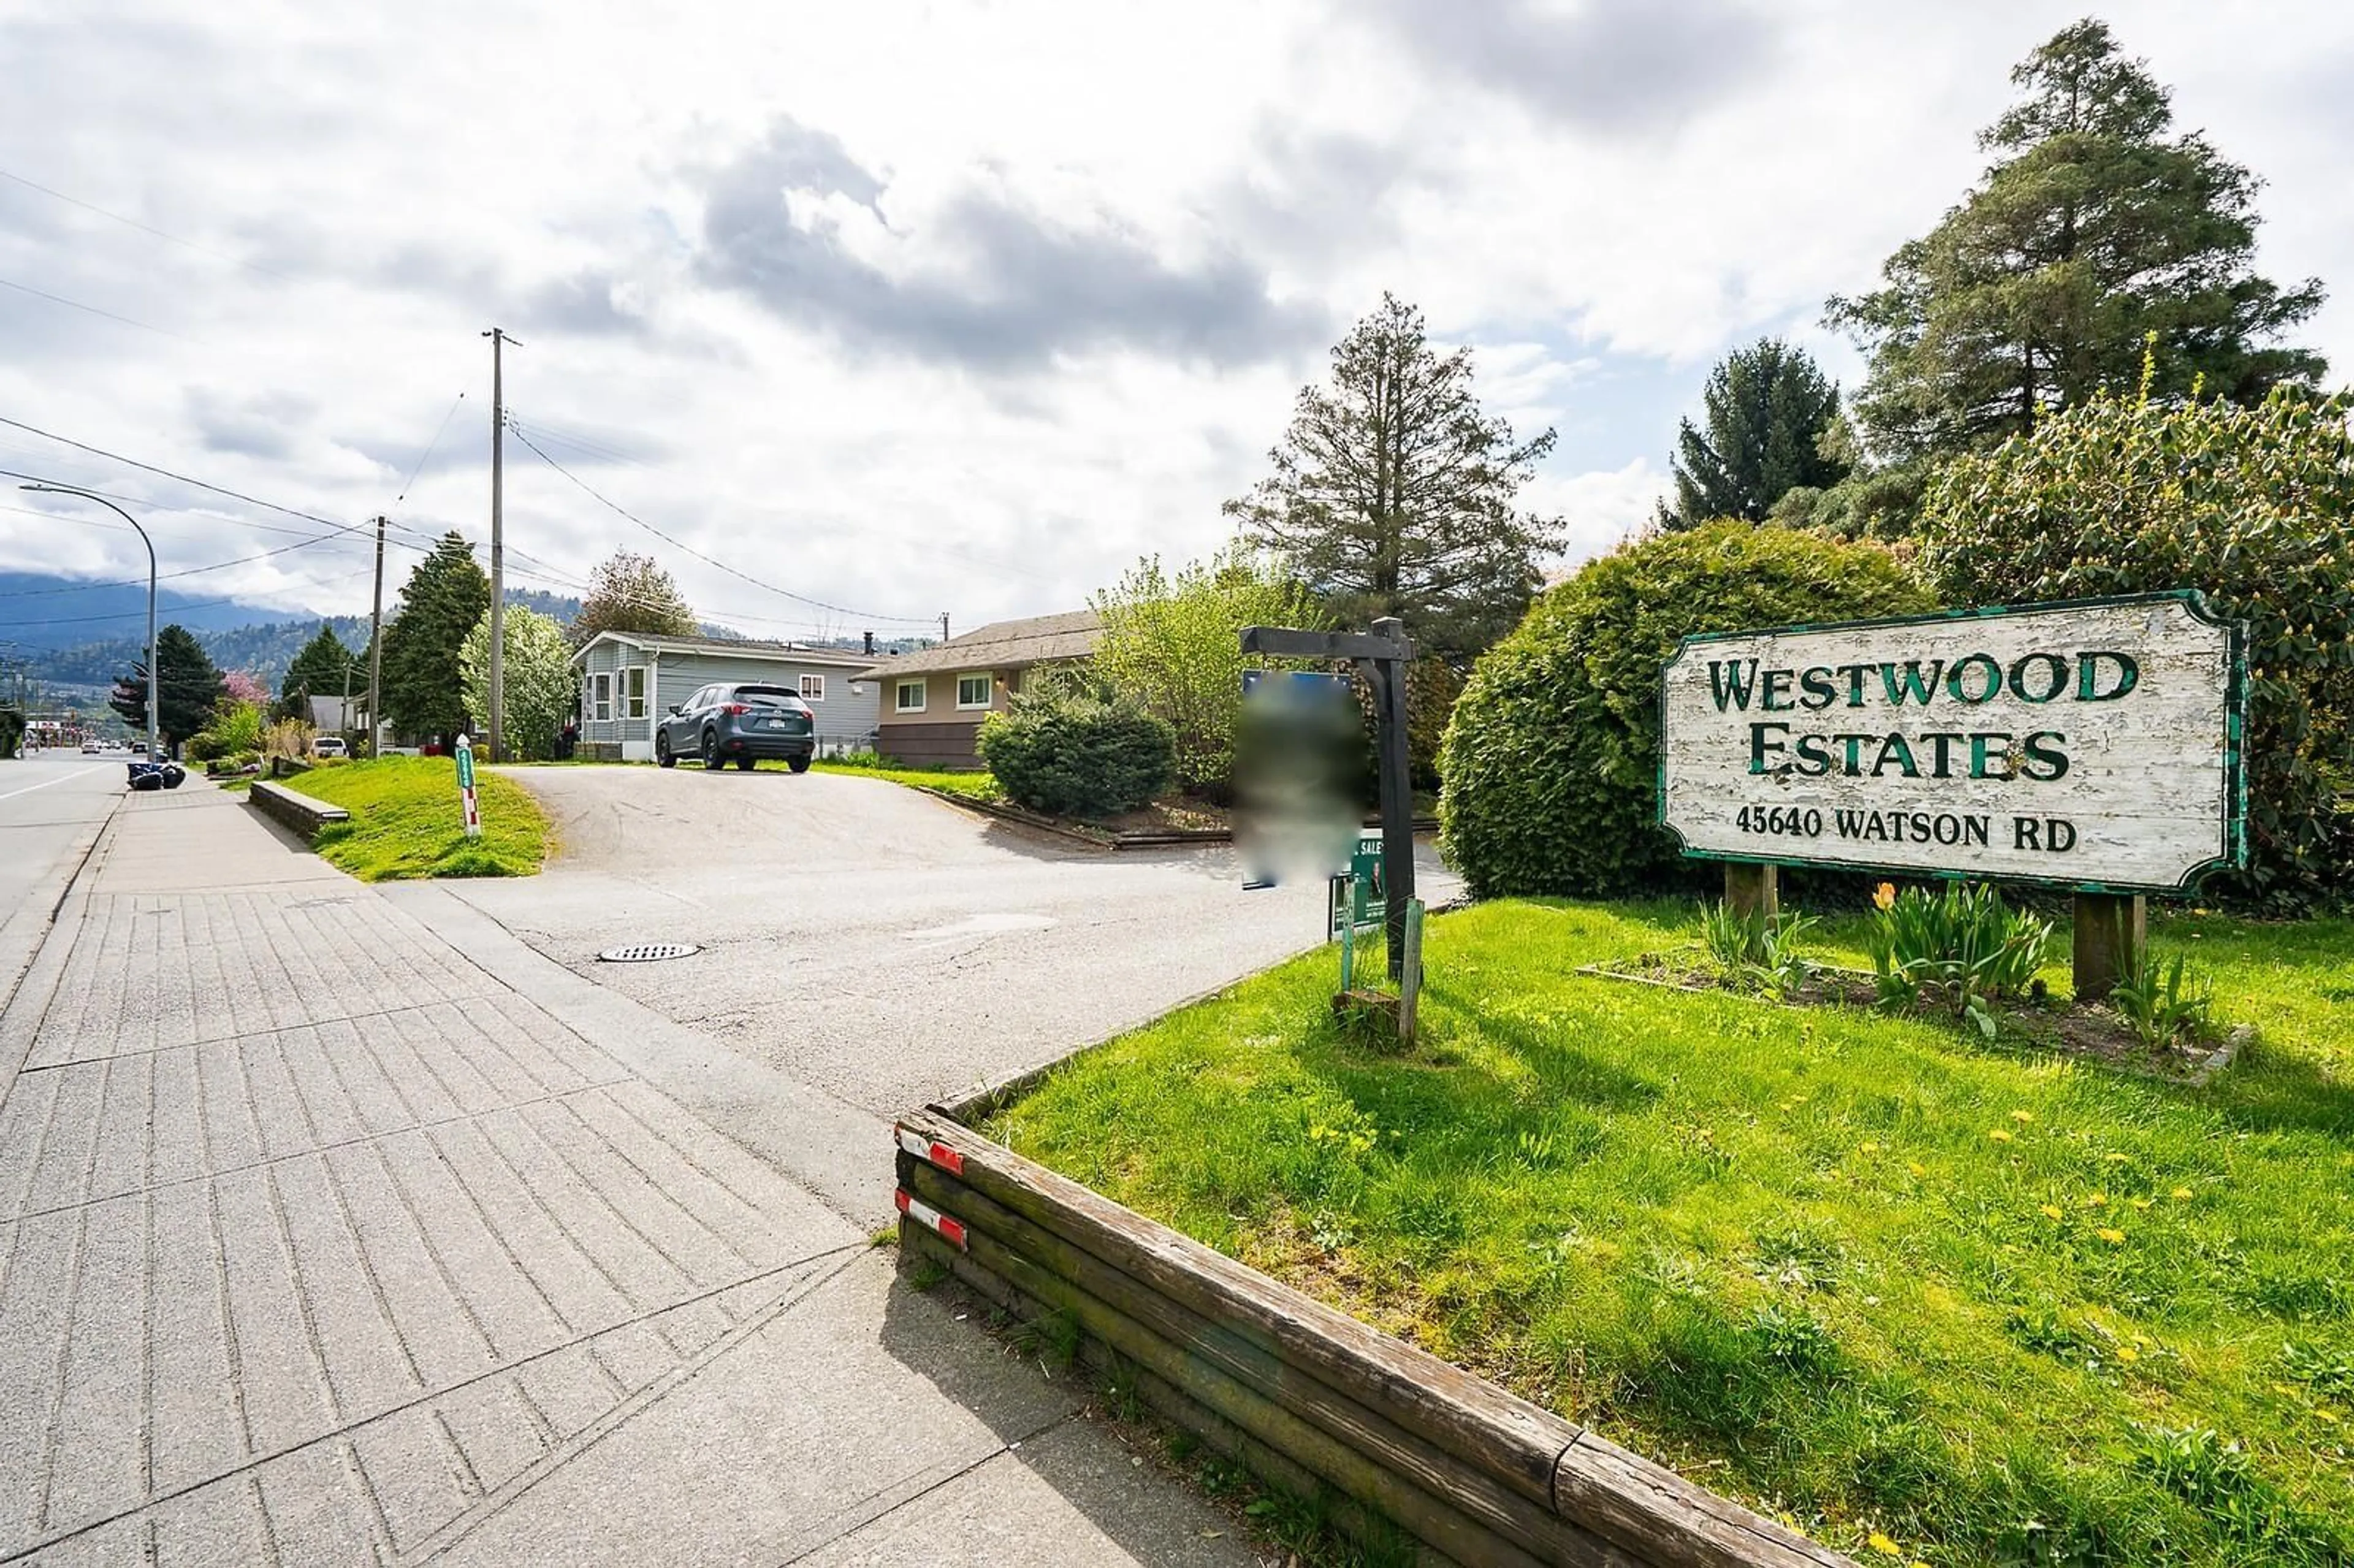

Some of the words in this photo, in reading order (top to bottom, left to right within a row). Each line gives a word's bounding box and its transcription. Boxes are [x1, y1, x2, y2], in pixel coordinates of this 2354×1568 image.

[1707, 651, 2139, 712] WESTWOOD
[1748, 721, 2070, 781] ESTATES
[1735, 805, 1823, 837] 45640
[1836, 809, 1990, 847] WATSON
[2013, 816, 2077, 852] RD
